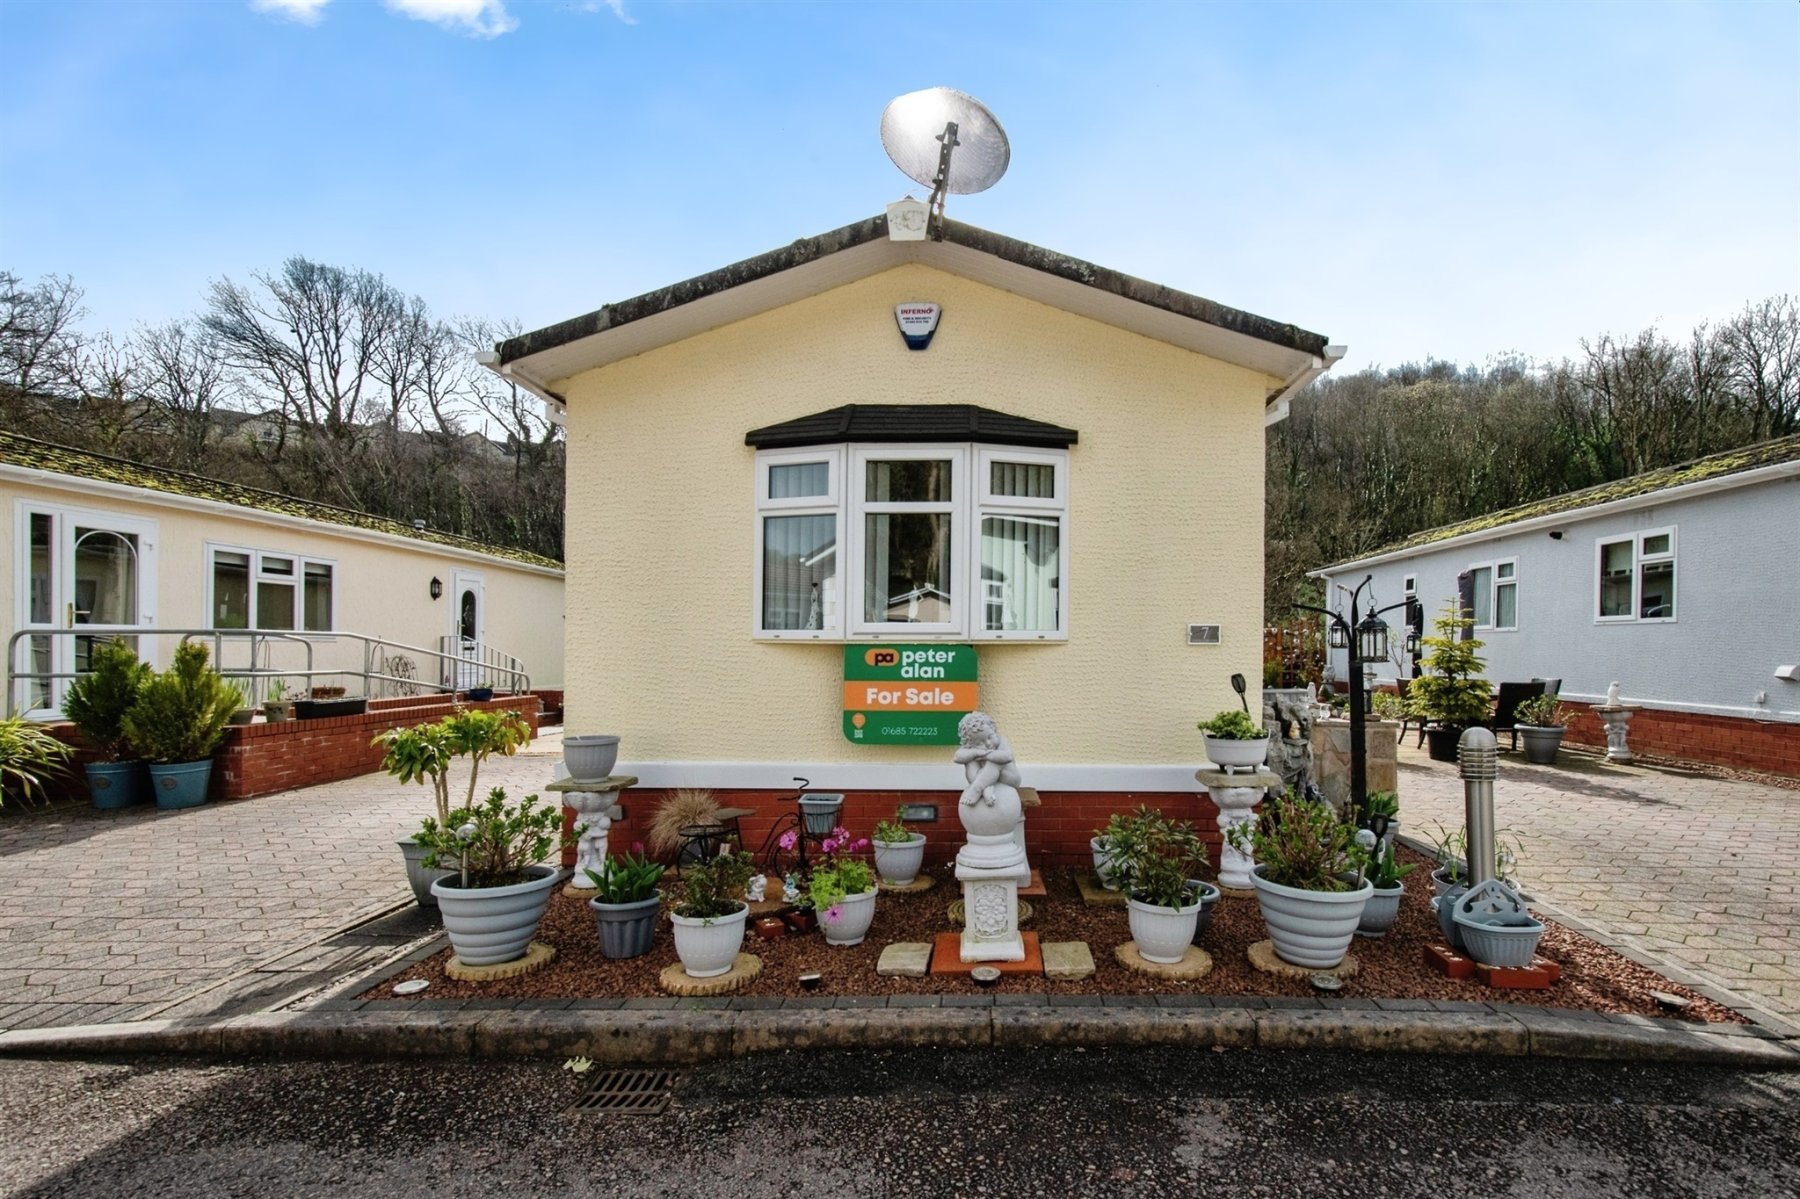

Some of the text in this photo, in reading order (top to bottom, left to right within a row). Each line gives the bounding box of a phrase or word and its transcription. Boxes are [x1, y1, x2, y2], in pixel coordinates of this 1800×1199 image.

[1201, 627, 1209, 639] 7
[902, 648, 956, 666] peter
[901, 663, 945, 678] alan
[866, 687, 955, 705] For Sale
[881, 727, 938, 736] 01685 722223
